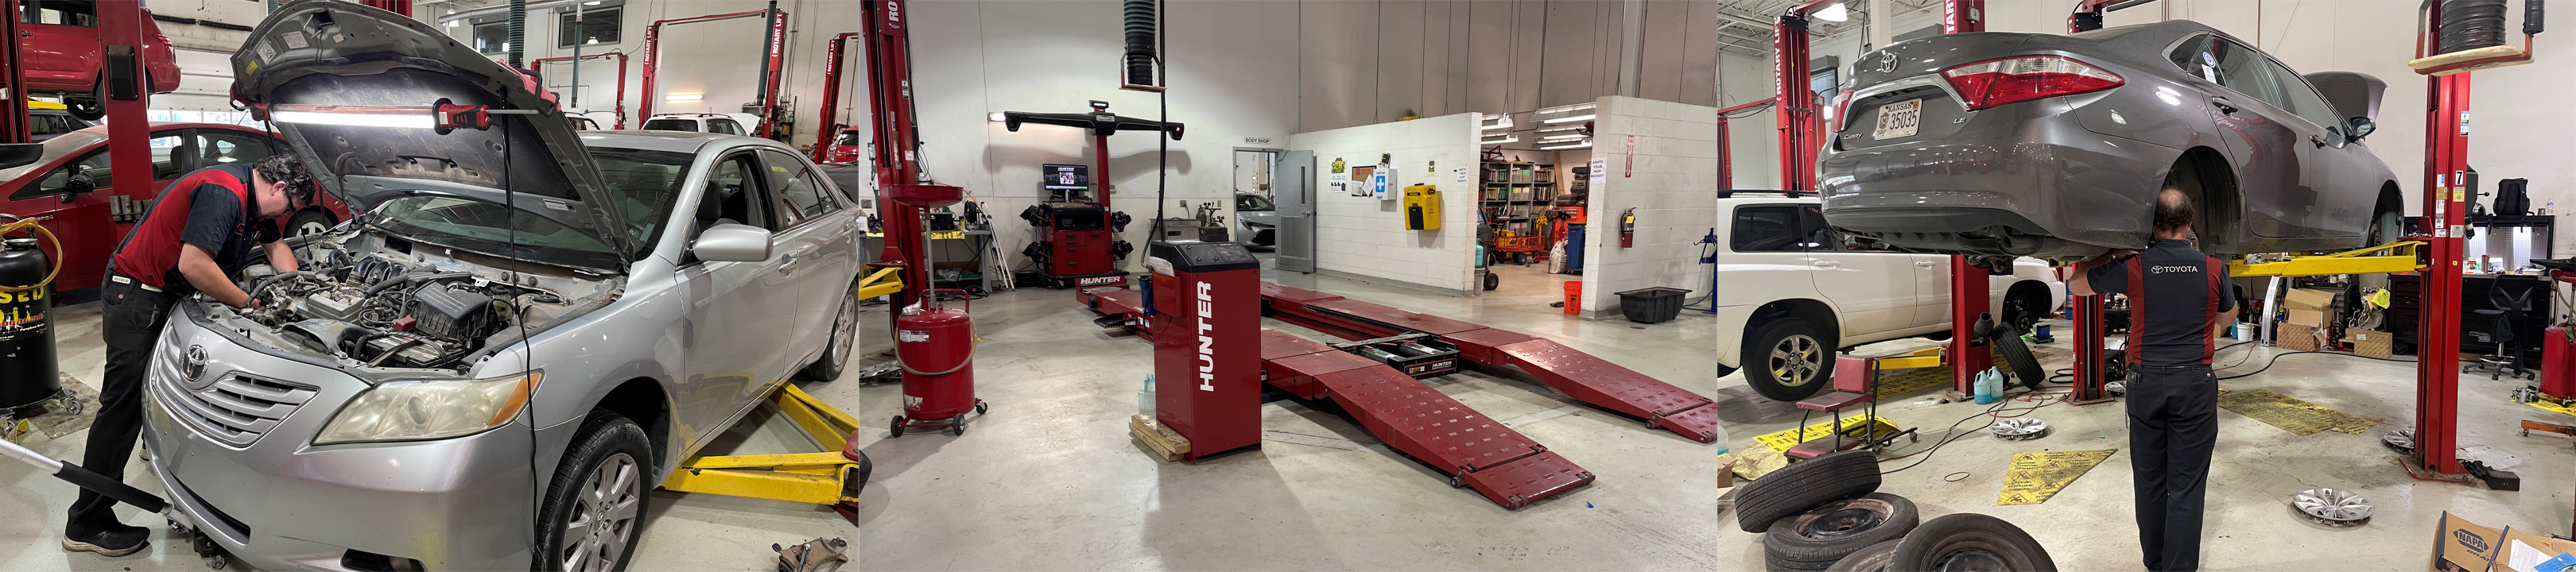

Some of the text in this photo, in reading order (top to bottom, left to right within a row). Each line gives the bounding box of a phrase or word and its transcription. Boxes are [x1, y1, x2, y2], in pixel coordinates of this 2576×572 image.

[1887, 102, 1912, 113] KANSAS
[1889, 109, 1918, 130] 35035
[2456, 171, 2463, 184] 7
[1080, 276, 1121, 285] HUNTER
[1197, 280, 1214, 392] HUNTER
[2458, 531, 2485, 551] NAPA
